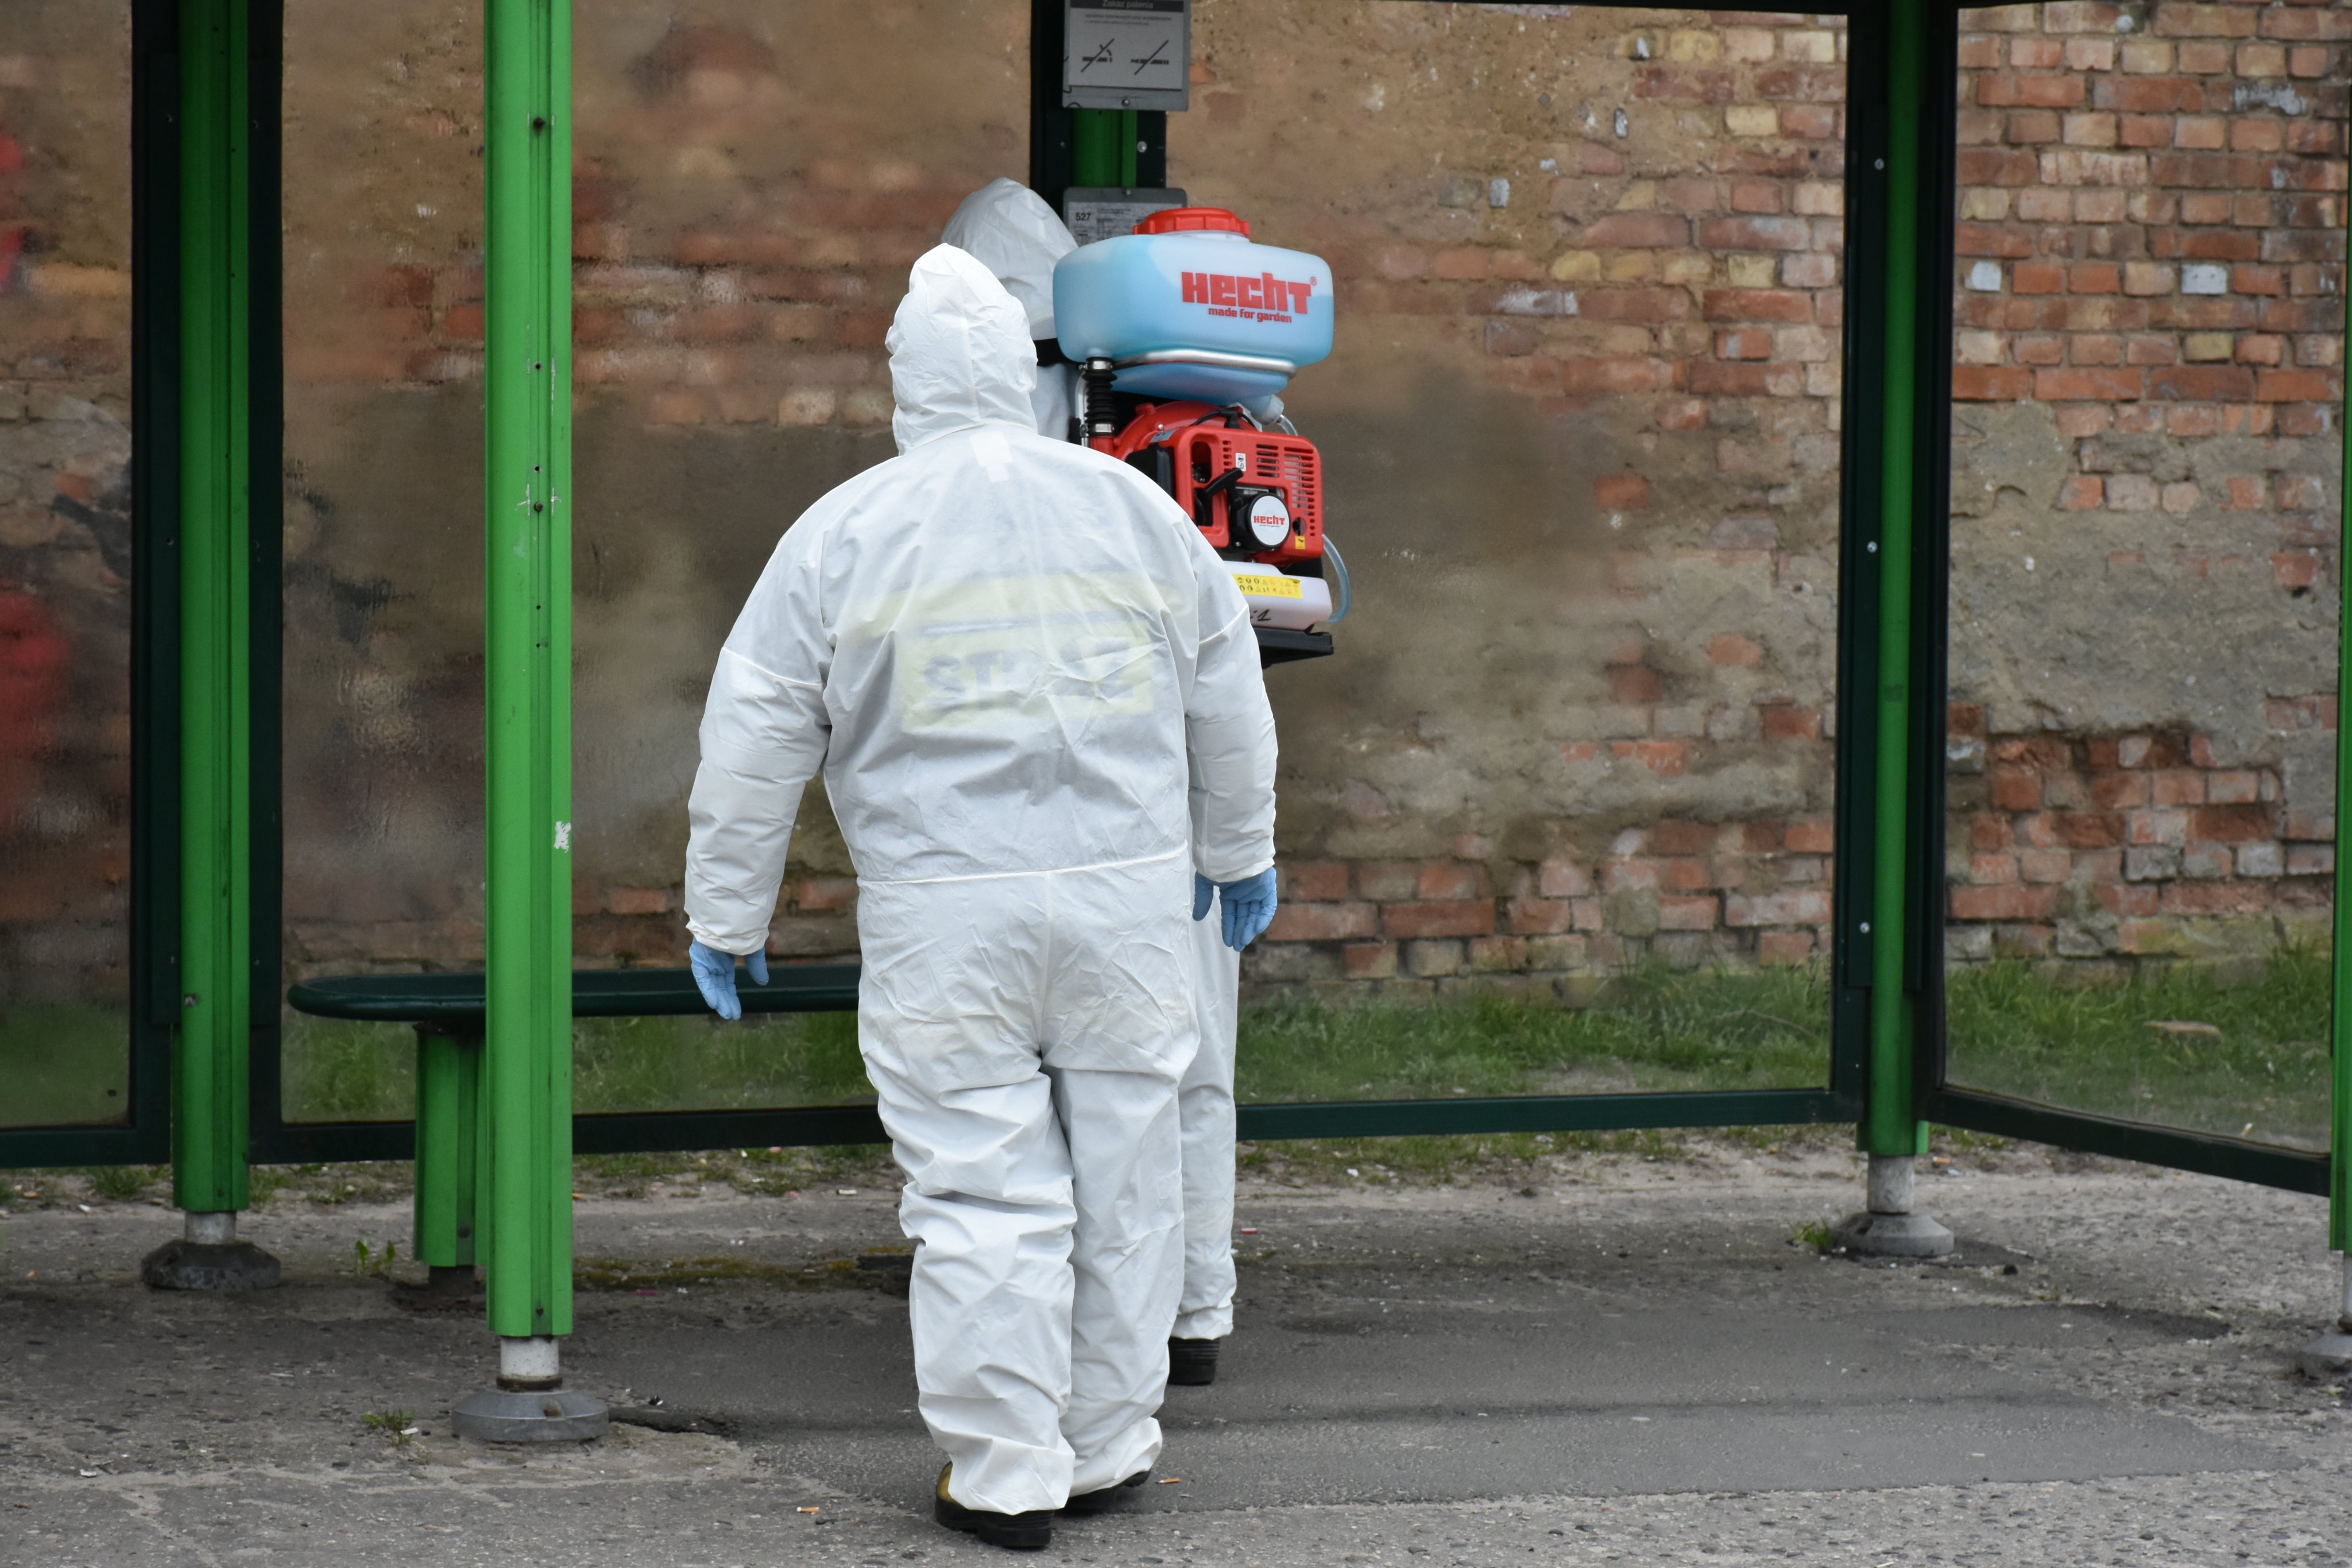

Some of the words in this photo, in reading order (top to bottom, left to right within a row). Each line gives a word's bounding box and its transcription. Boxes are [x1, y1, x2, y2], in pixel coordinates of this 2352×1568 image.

[1076, 212, 1091, 221] 527
[1208, 308, 1237, 318] made
[1240, 309, 1255, 319] for
[1256, 312, 1293, 323] garden
